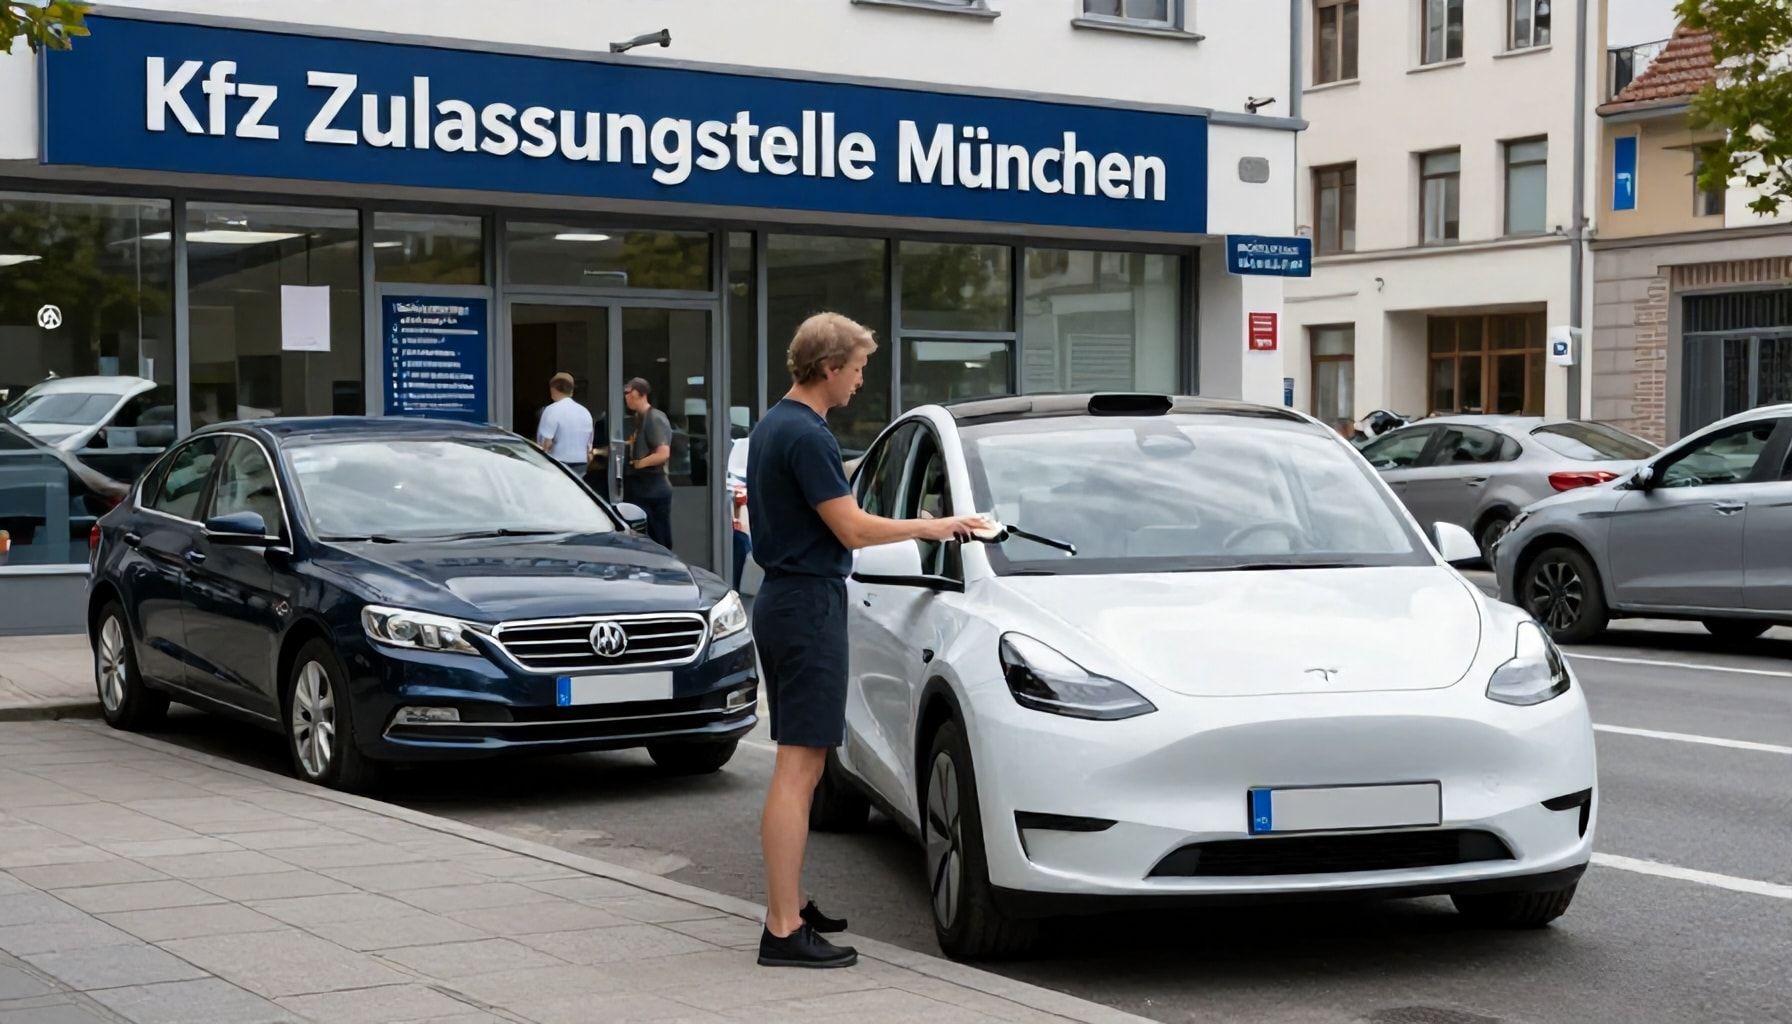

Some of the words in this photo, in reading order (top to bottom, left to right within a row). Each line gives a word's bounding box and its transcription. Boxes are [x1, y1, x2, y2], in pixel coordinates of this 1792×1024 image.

[145, 55, 280, 141] Kfz
[305, 70, 877, 186] Zulassungstelle
[897, 118, 1167, 202] München
